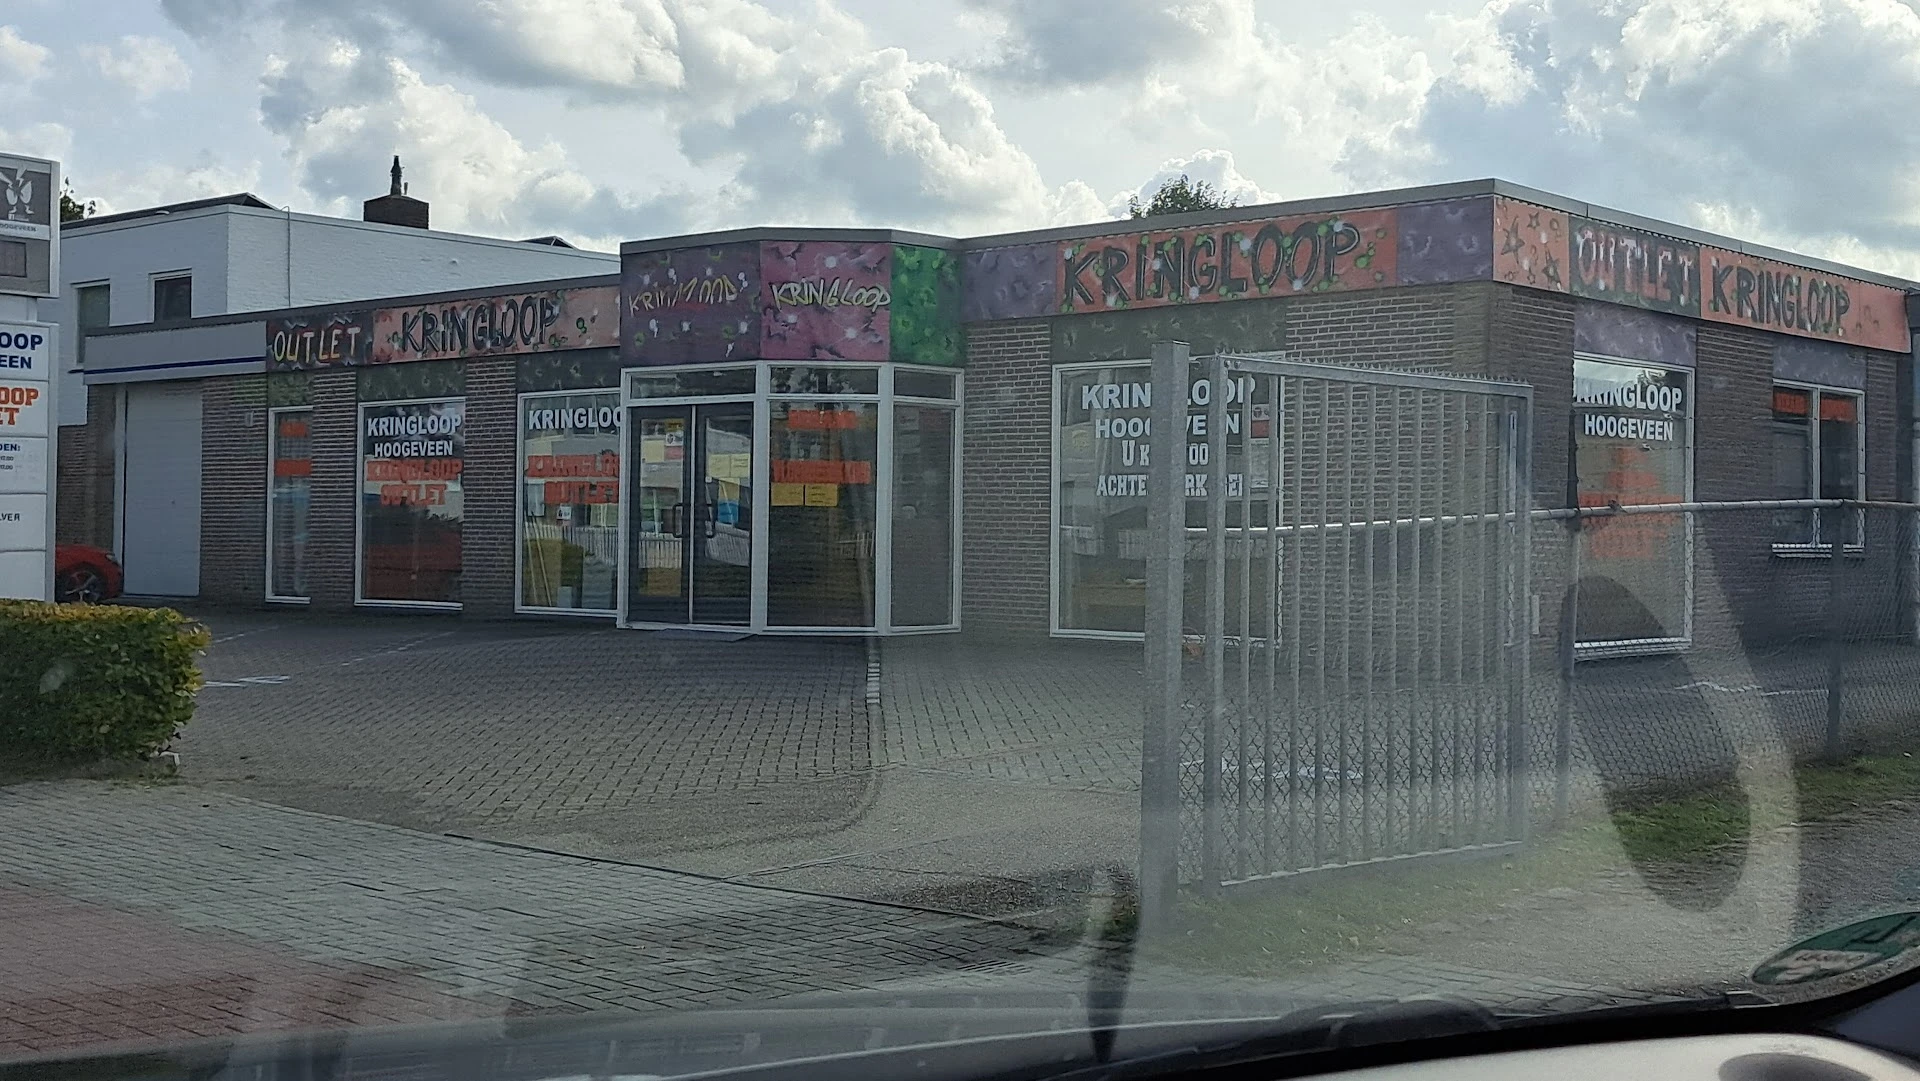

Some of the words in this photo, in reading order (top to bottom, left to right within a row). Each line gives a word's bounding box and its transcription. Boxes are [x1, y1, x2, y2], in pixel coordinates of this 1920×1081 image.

[1063, 222, 1361, 306] KRINGLOOP
[1577, 226, 1697, 304] OUTLET
[768, 277, 891, 313] KRINGLOOP
[1711, 257, 1851, 336] KRINGLOOP
[401, 296, 560, 354] KRINGLOOP
[273, 326, 361, 363] OUTLET
[1082, 377, 1256, 410] KRINOP
[0, 407, 20, 425] T
[367, 415, 462, 437] KRINGLOOP
[1095, 413, 1240, 439] HOOEN
[1585, 414, 1674, 442] HOOGEVEEN
[374, 440, 453, 457] HOOGEVEEN
[1096, 474, 1149, 497] ACHTE
[0, 512, 20, 521] VER
